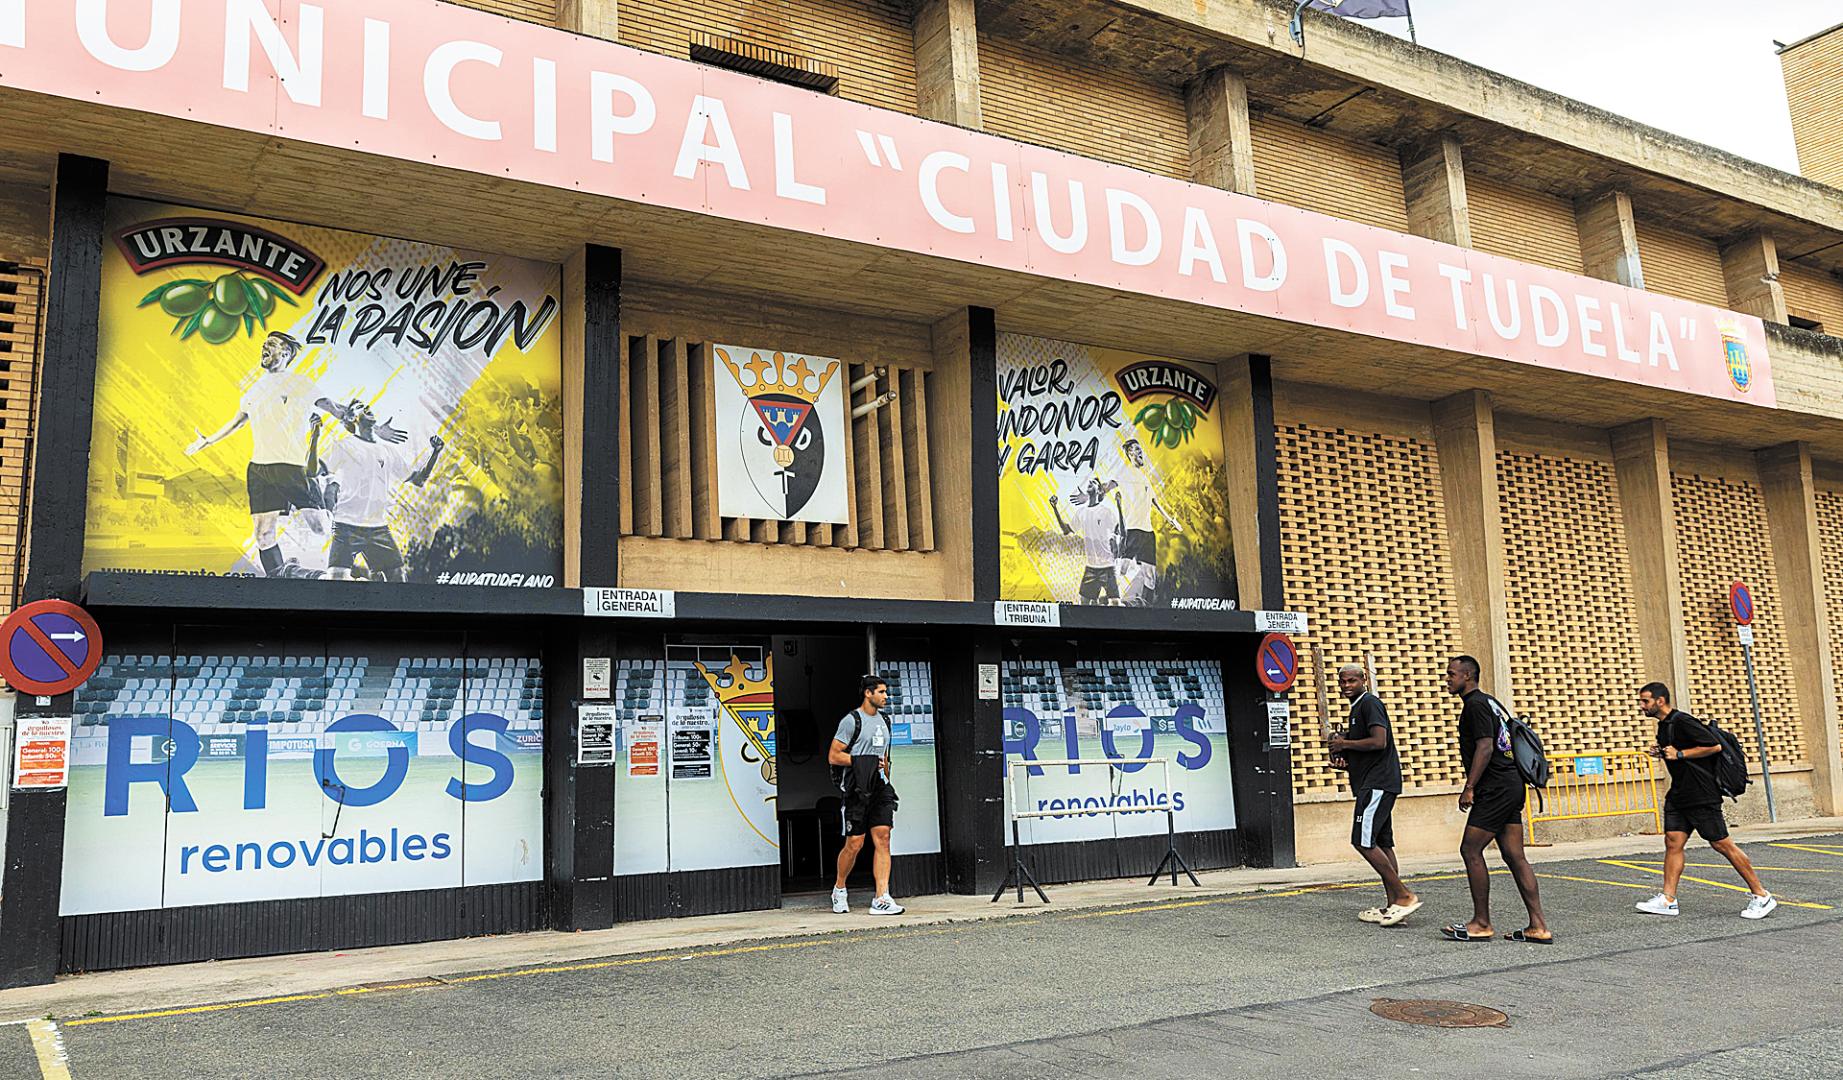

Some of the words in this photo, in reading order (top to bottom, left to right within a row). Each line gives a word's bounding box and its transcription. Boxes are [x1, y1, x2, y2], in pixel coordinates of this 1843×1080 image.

[0, 0, 826, 206] UNICIPAL
[1323, 238, 1416, 321] DE
[134, 227, 306, 280] URZANTE
[318, 268, 393, 307] NOS
[396, 261, 487, 303] UNE
[306, 304, 347, 345] LA
[350, 286, 556, 357] PASIÓN
[1125, 366, 1208, 402] URZANTE
[1017, 436, 1099, 476] GARRA
[602, 590, 657, 601] ENTRADA
[602, 601, 658, 612] GENERAL
[1171, 597, 1236, 611] #AUPATUDELANO
[1007, 603, 1047, 613] ENTRADA
[1009, 614, 1046, 623] TRIBUNA
[1266, 612, 1298, 621] ENTRADA
[1268, 621, 1299, 629] GENERL
[516, 735, 543, 743] ZURIC
[1038, 788, 1184, 820] renovables
[181, 828, 451, 874] renovables
